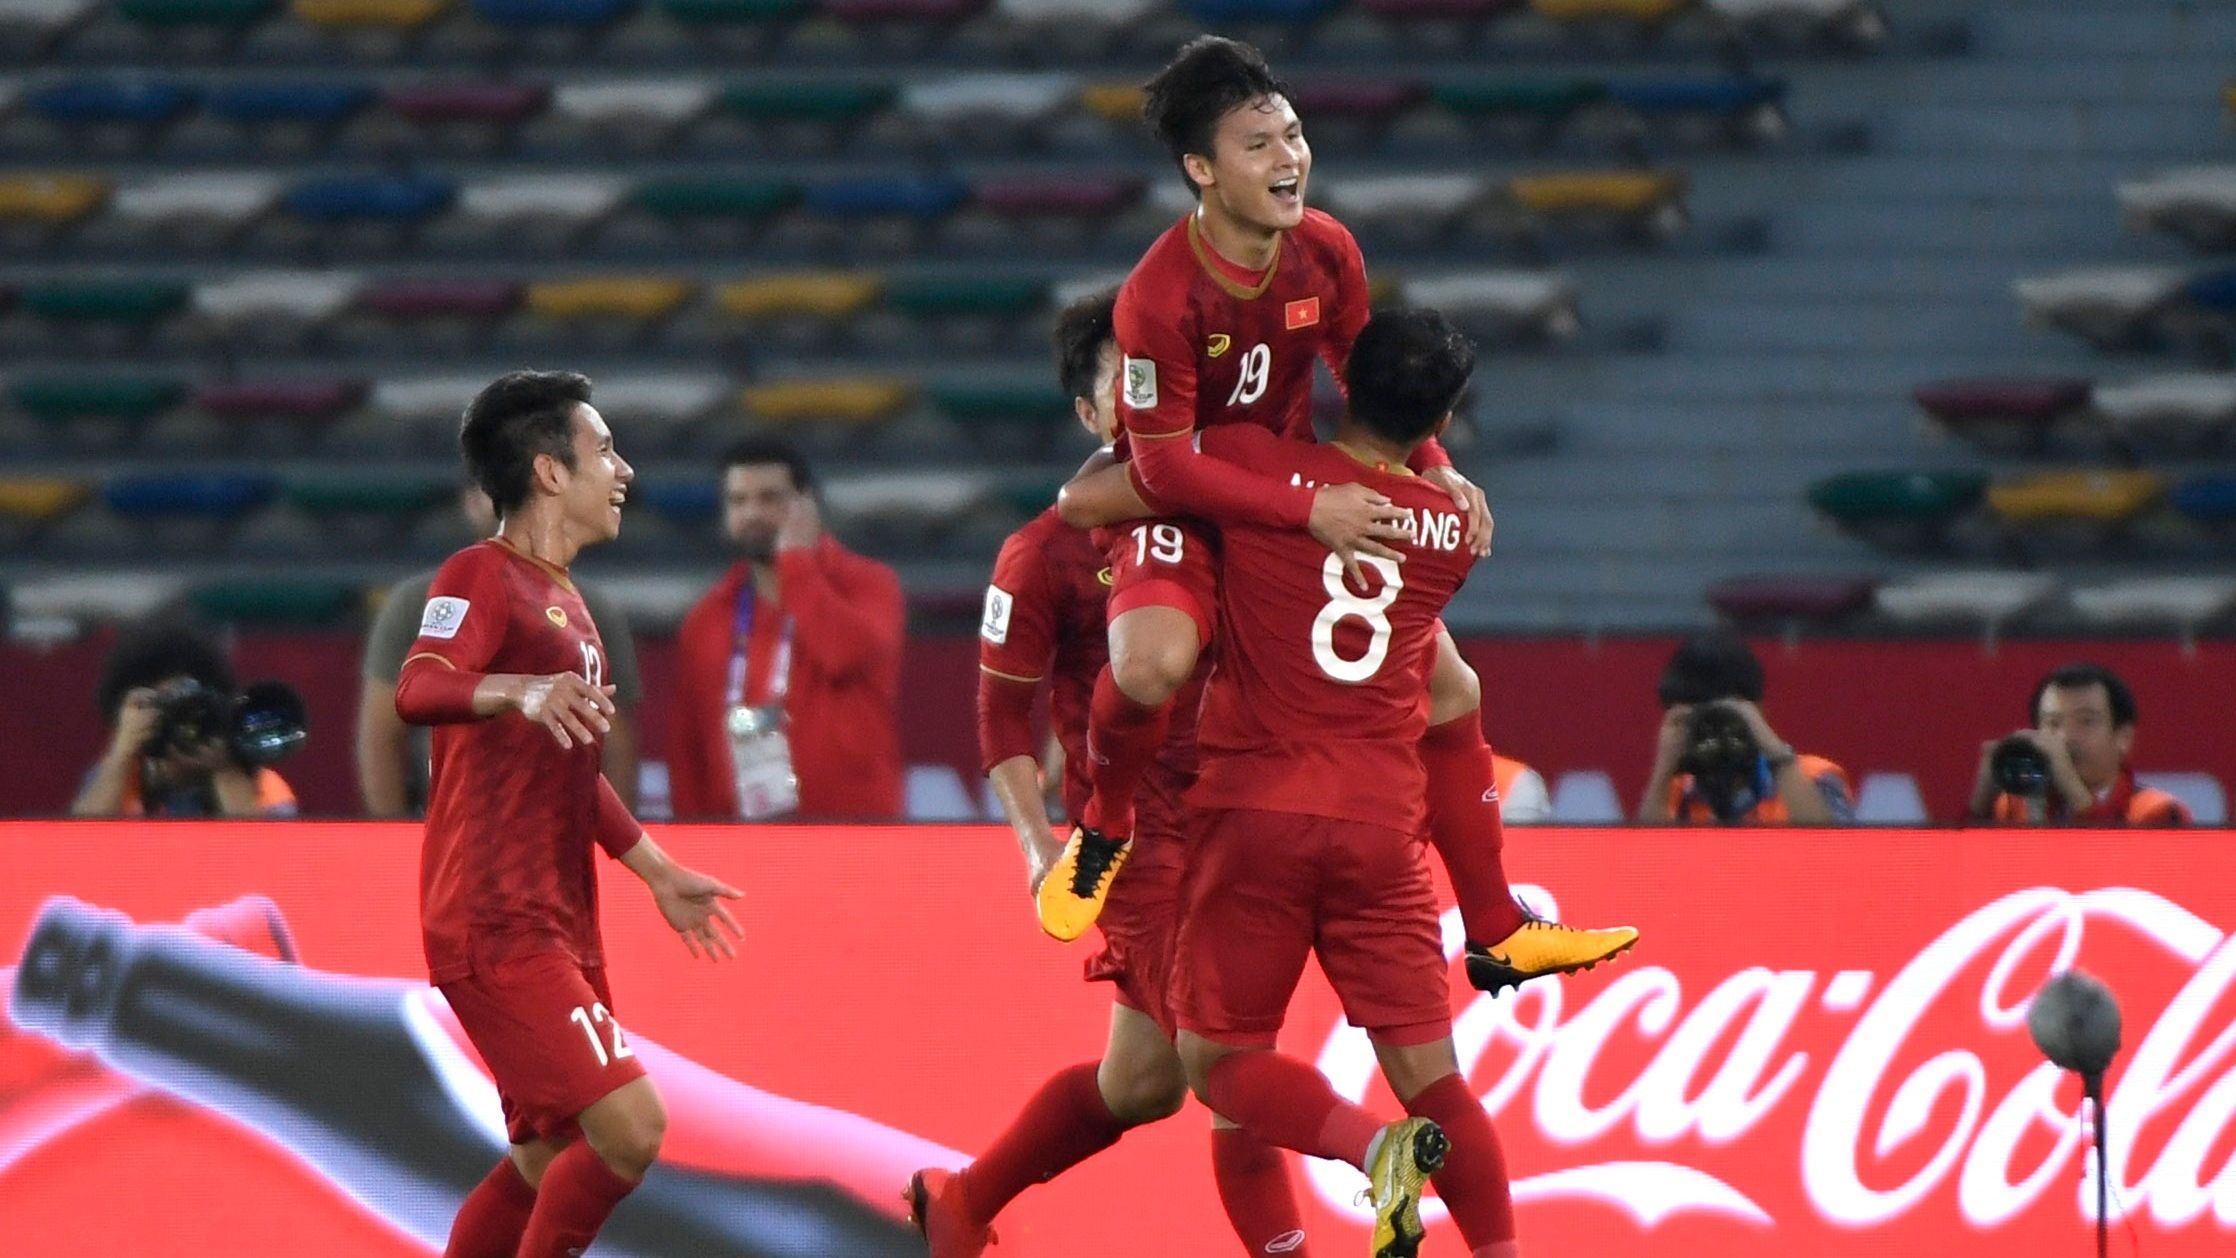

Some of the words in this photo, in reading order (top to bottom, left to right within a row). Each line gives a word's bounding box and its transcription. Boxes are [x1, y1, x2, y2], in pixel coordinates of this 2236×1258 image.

[1227, 342, 1271, 406] 19
[1131, 523, 1184, 566] 19
[1312, 551, 1404, 681] 8
[570, 1001, 634, 1067] 12
